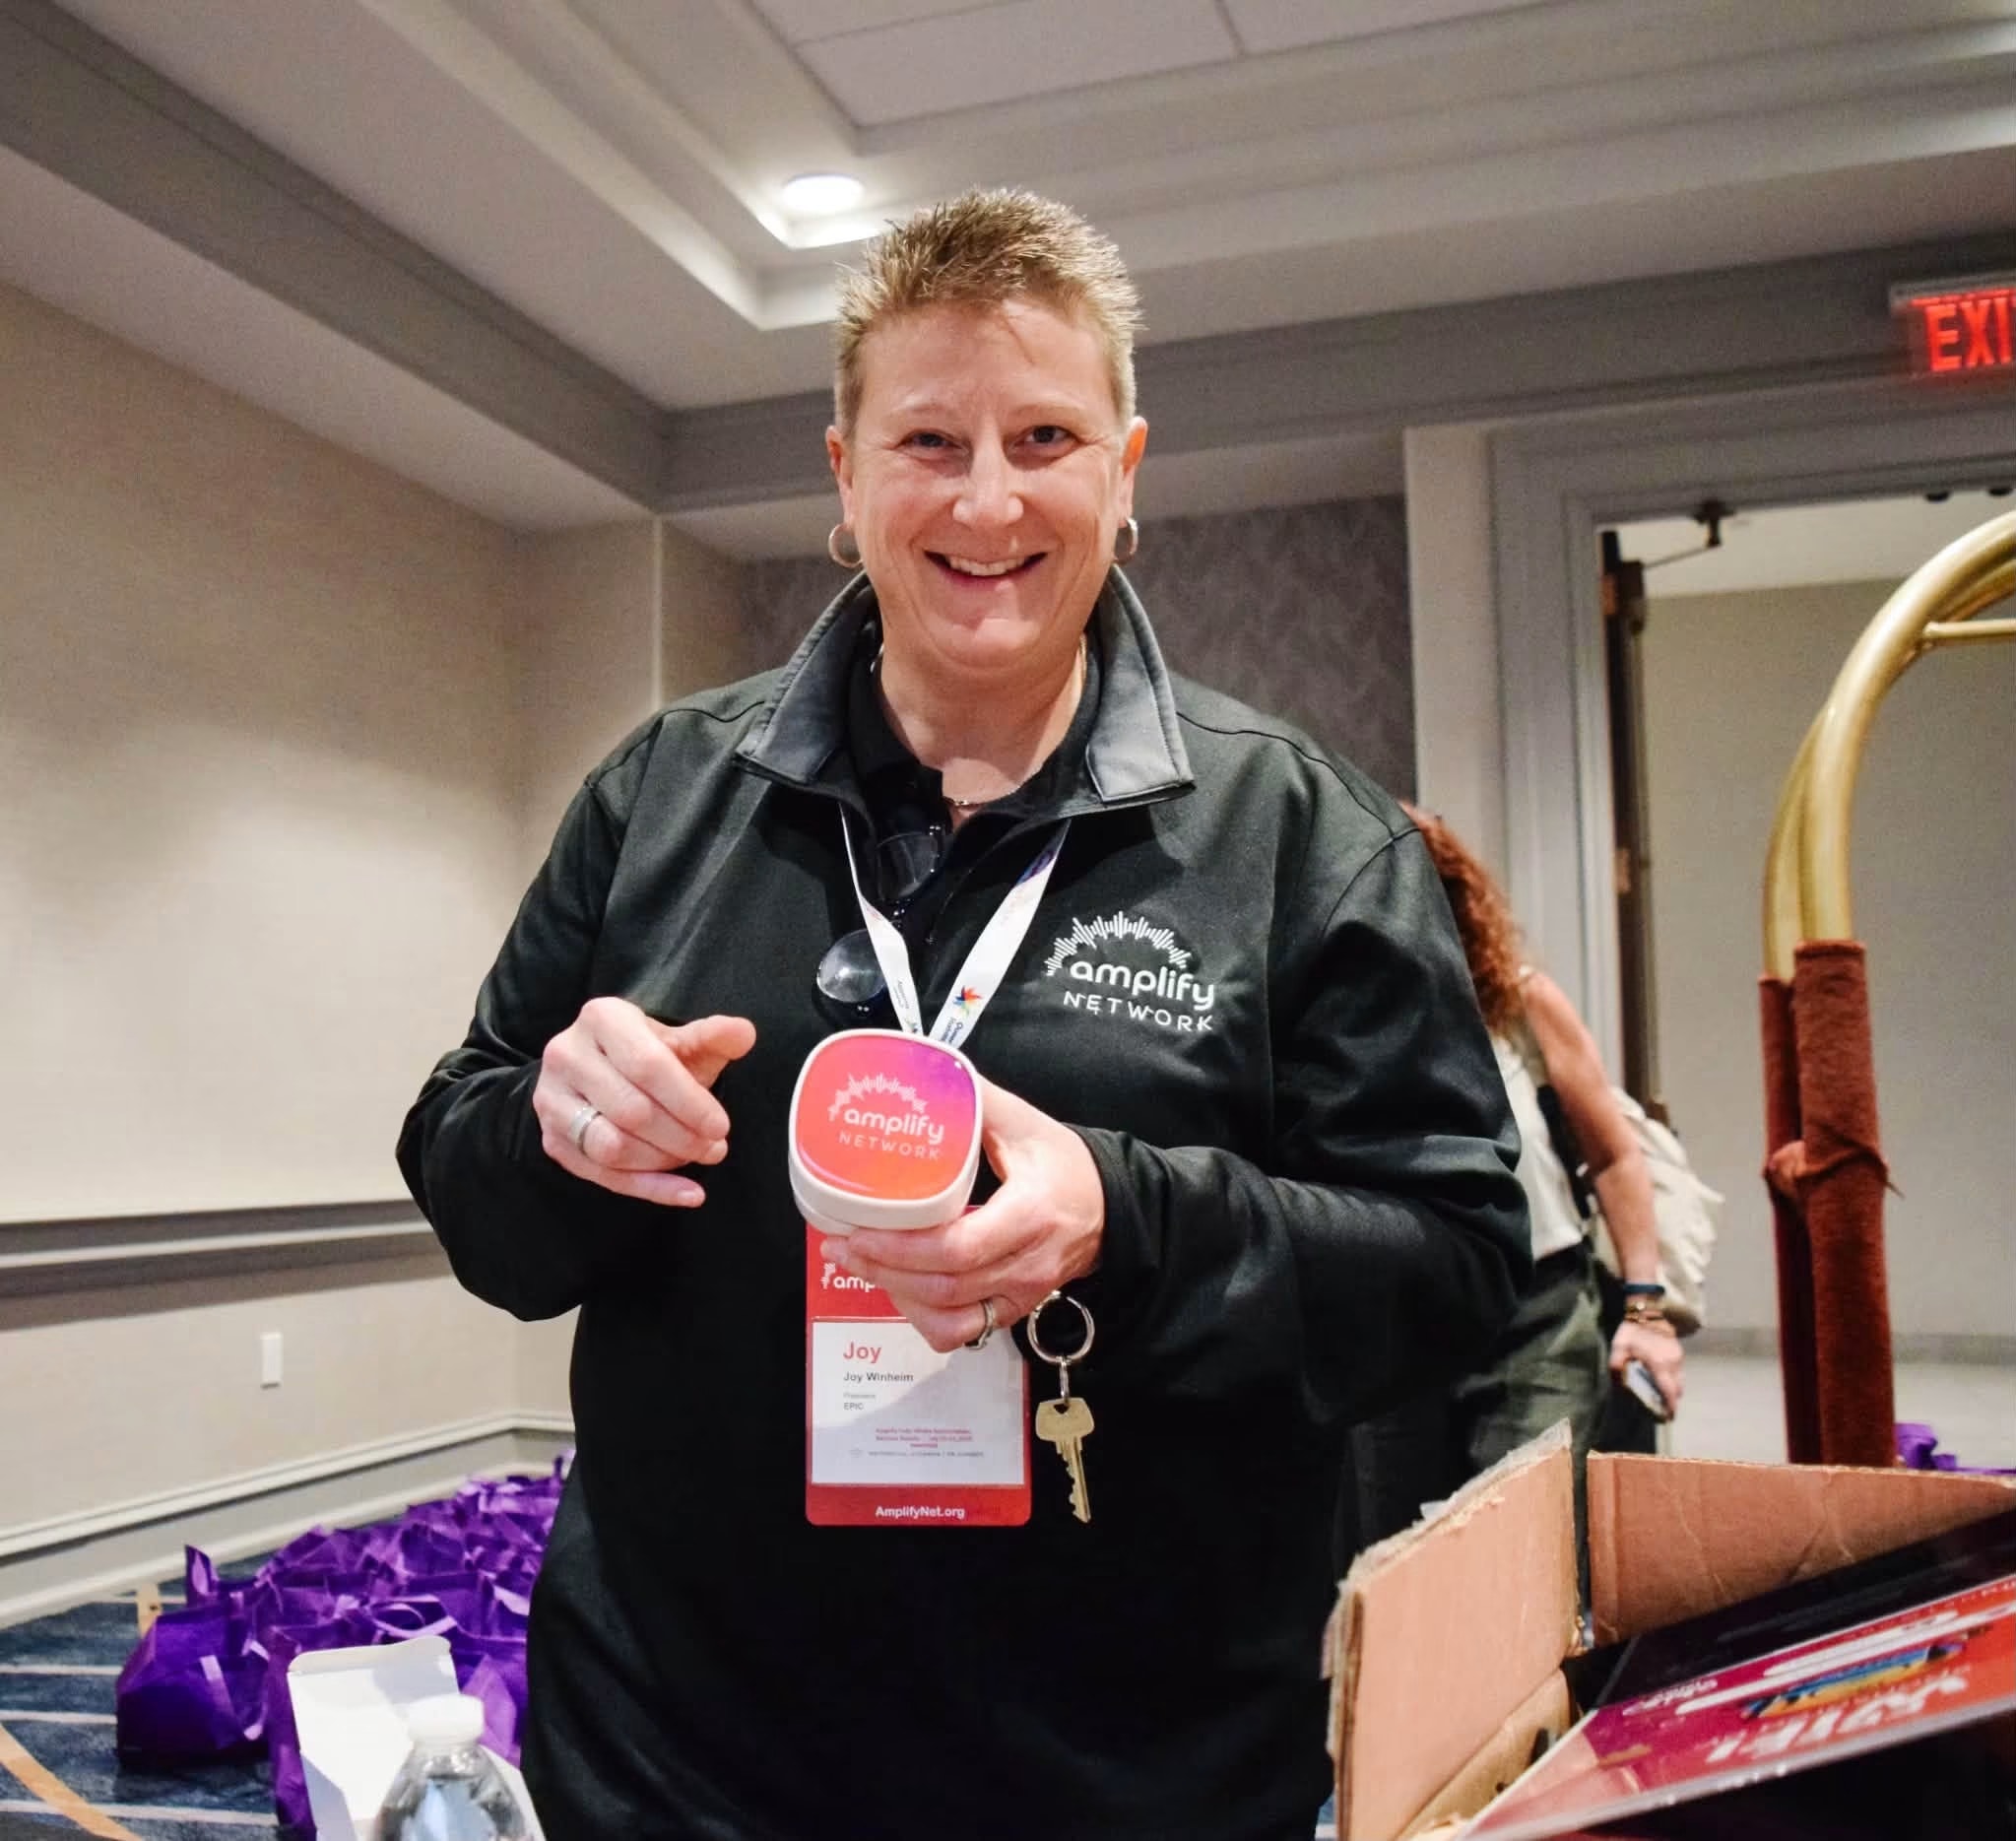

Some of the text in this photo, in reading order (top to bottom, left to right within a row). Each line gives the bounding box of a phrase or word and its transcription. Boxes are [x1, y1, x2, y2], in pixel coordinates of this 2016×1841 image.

[1925, 297, 2016, 371] EXI
[1070, 961, 1214, 1012] amplify
[1063, 991, 1213, 1032] NETWORK
[843, 1108, 944, 1145] amplify
[839, 1131, 942, 1160] NETWORK
[843, 1342, 881, 1364] Joy
[843, 1372, 914, 1383] Joy Winheim
[843, 1402, 864, 1411] EPIC
[876, 1506, 965, 1519] AmplifyNet.org
